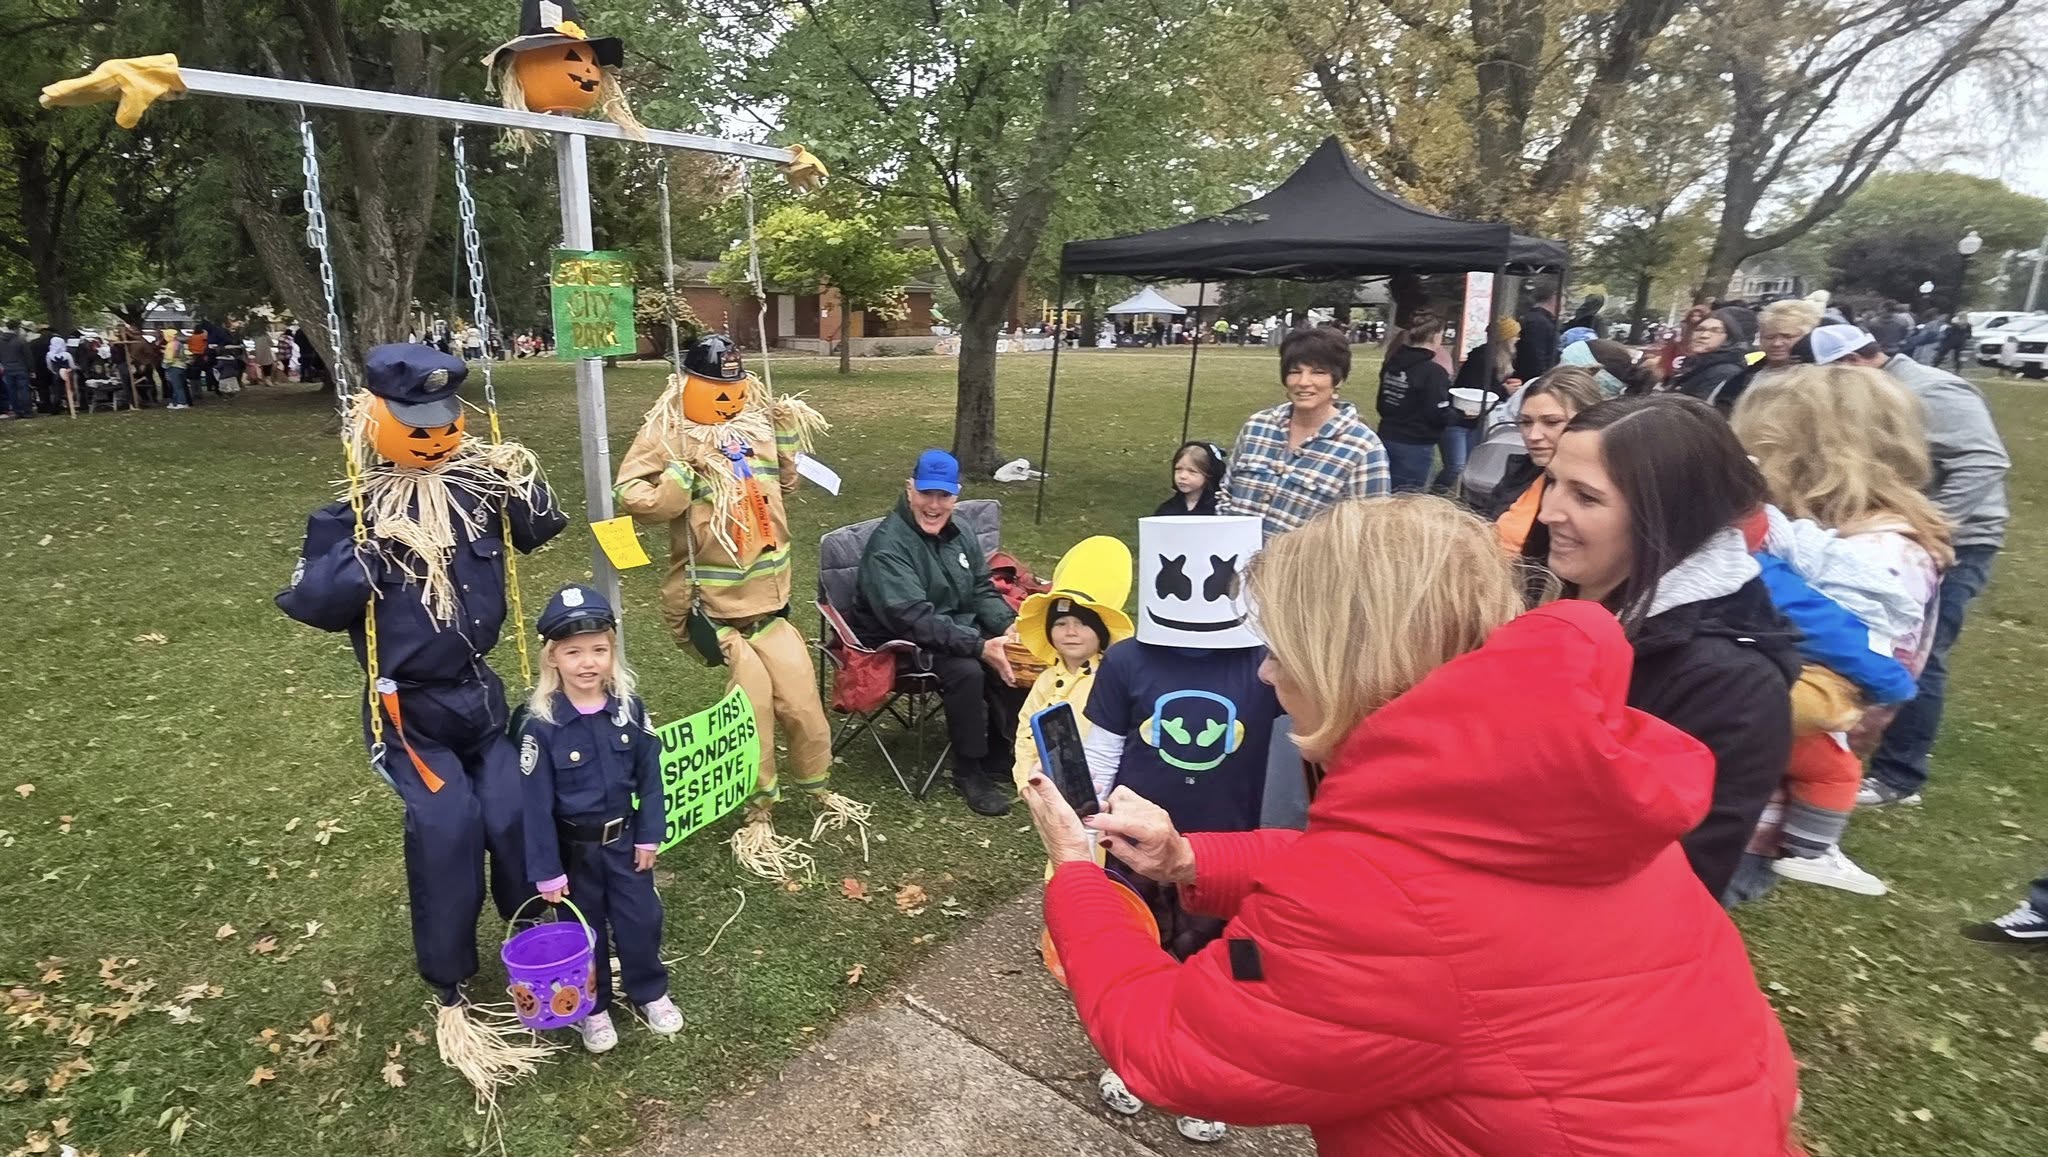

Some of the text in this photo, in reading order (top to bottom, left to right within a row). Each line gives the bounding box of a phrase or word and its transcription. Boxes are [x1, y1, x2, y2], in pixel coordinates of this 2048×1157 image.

[661, 692, 745, 753] UR FIRST
[664, 717, 755, 786] SPONDERS
[664, 763, 753, 844] OME FUN!
